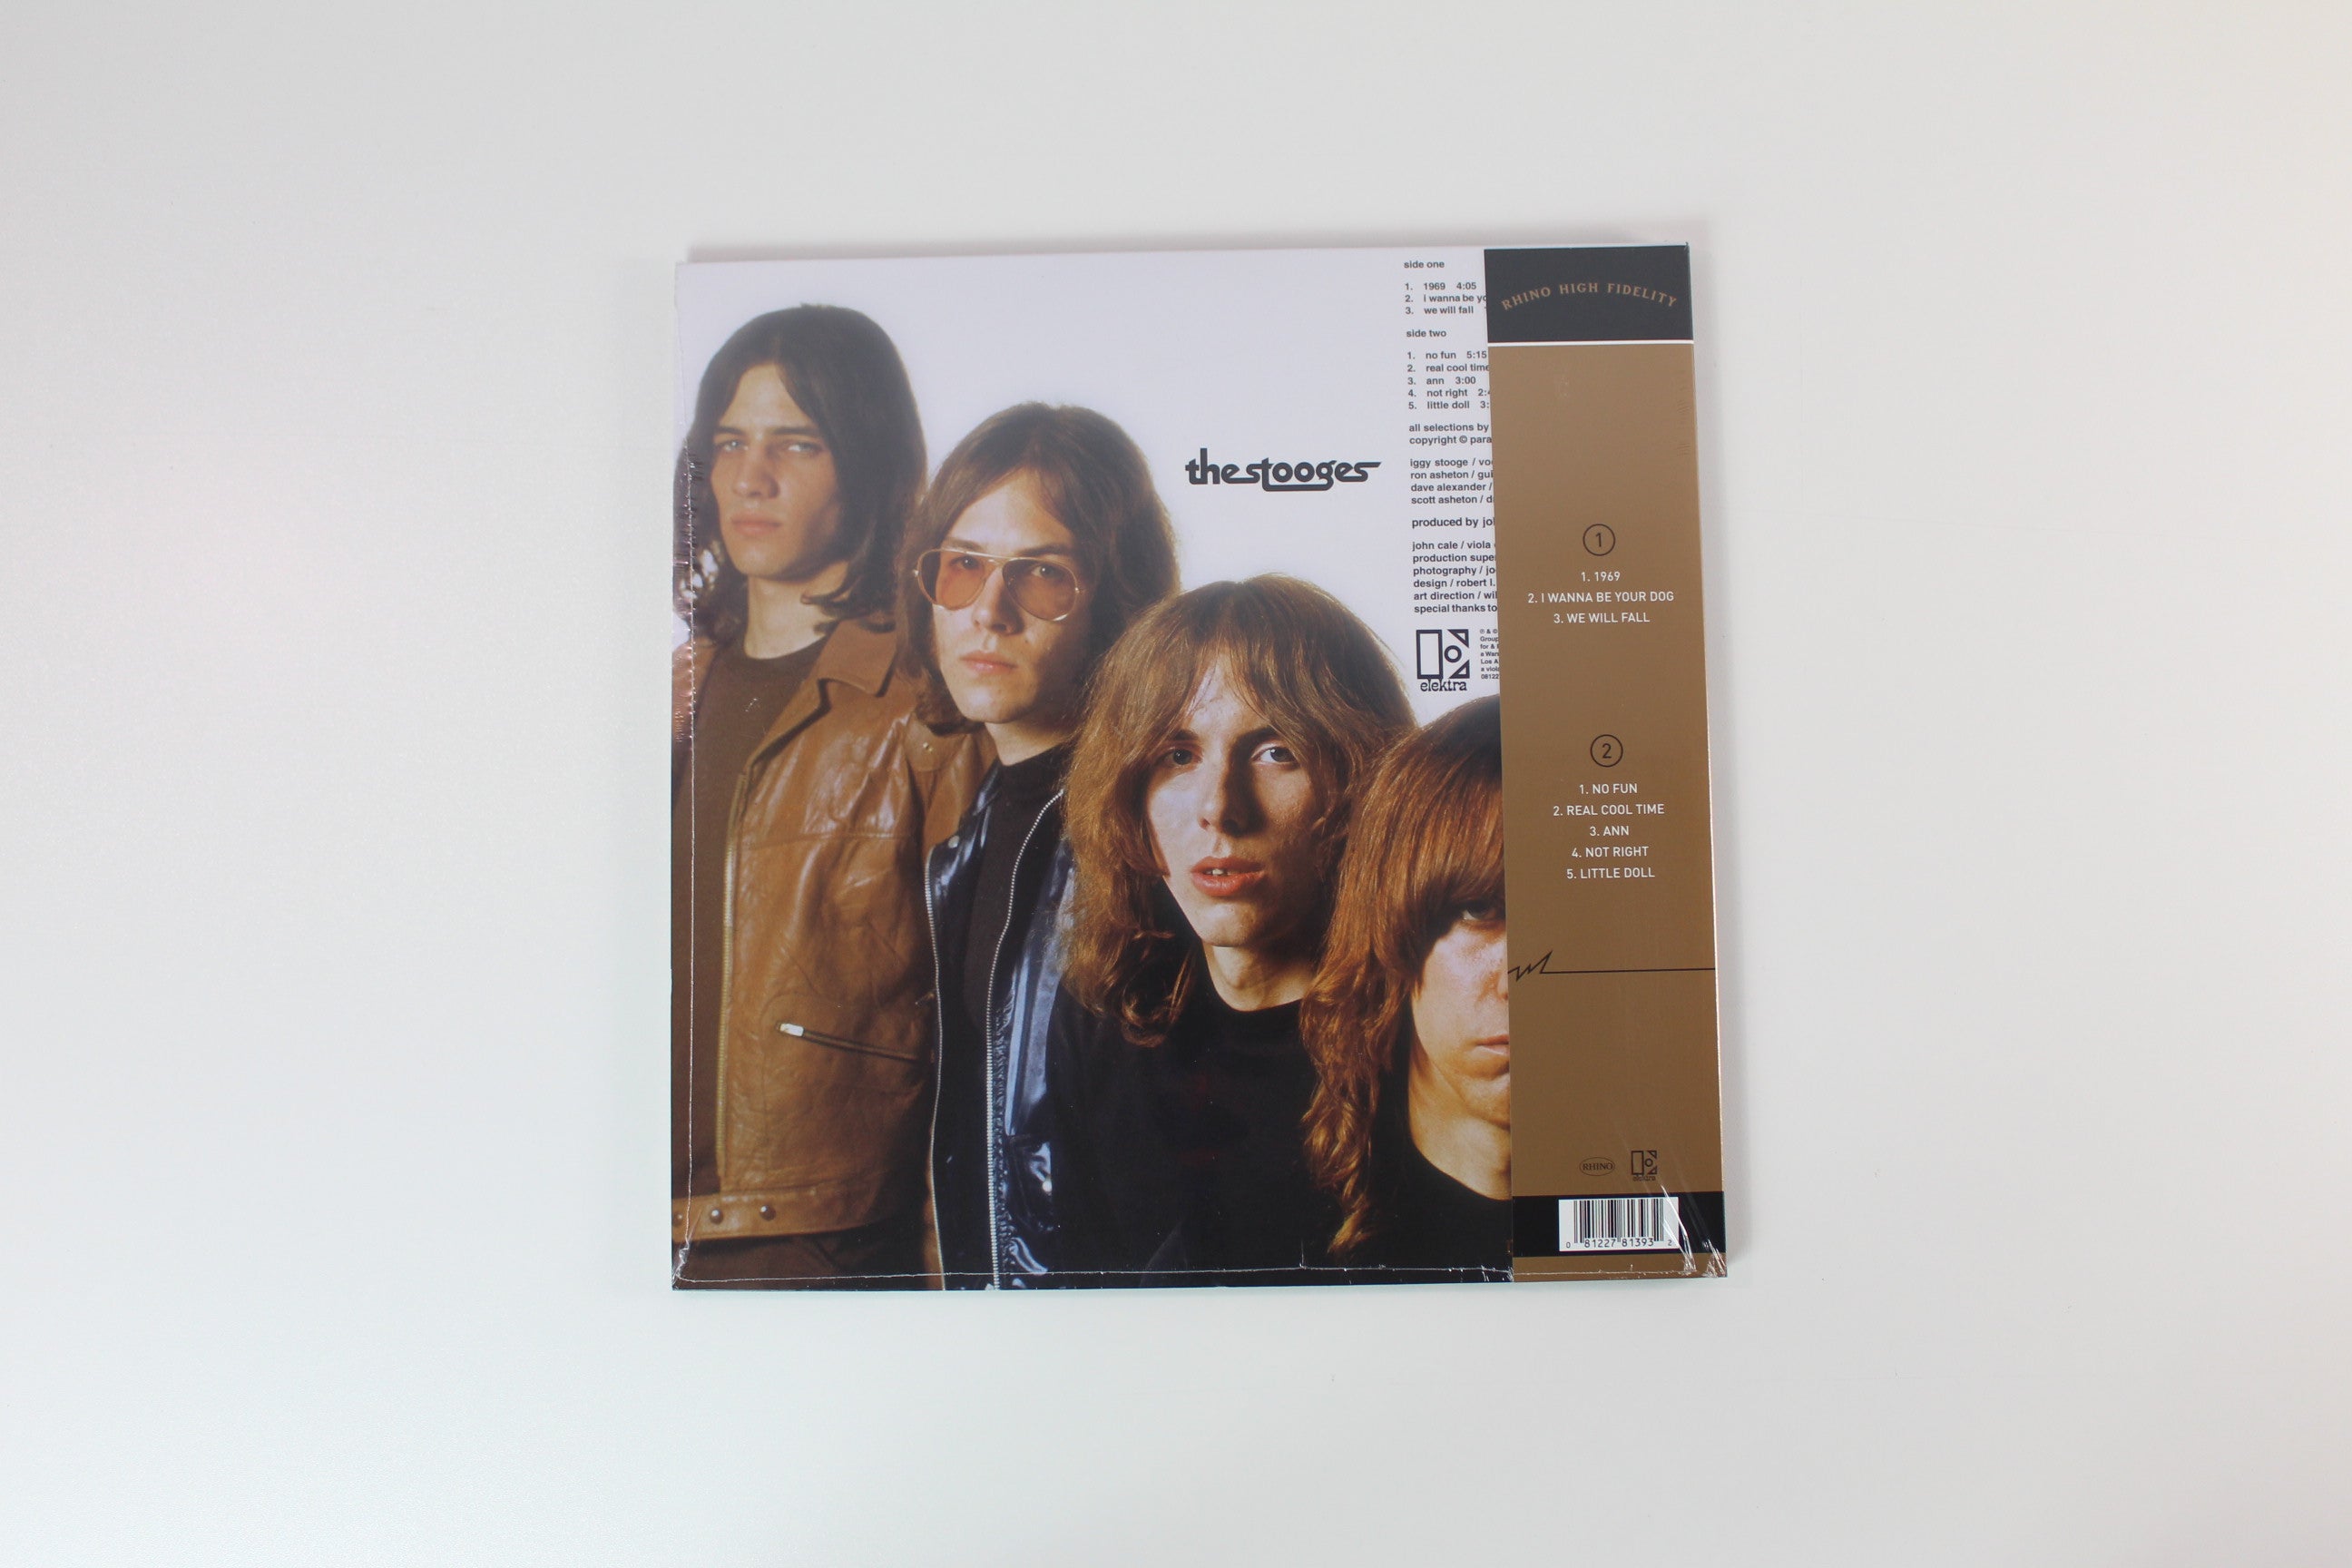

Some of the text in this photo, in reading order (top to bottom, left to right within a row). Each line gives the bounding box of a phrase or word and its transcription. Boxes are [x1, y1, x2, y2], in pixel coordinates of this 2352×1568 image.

[1404, 260, 1424, 269] side
[1501, 282, 1677, 310] RHINO HIGH FIDELITY
[1406, 329, 1426, 338] side
[1441, 351, 1456, 359] fun
[1426, 364, 1444, 372] real
[1446, 388, 1468, 398] right
[1426, 401, 1449, 409] little
[1424, 423, 1474, 431] selections
[1477, 423, 1489, 433] by
[1409, 436, 1456, 446] copyright
[1410, 459, 1431, 468] iggy
[1435, 458, 1468, 468] stooge
[1429, 471, 1469, 479] asheton
[1411, 484, 1434, 492] dave
[1436, 483, 1486, 491] alexander
[1411, 496, 1436, 505] scott
[1438, 495, 1477, 504] asheton
[1412, 517, 1462, 529] produced
[1465, 517, 1478, 528] by
[1595, 533, 1602, 547] 1
[1412, 542, 1435, 552] john
[1437, 541, 1458, 550] cale
[1466, 541, 1491, 549] viola
[1413, 554, 1467, 564] production
[1413, 566, 1476, 577] photography
[1582, 572, 1621, 582] 1. 1969
[1414, 579, 1447, 589] design
[1456, 579, 1487, 587] robert
[1414, 593, 1427, 601] art
[1430, 592, 1475, 600] direction
[1528, 593, 1537, 603] 2.
[1548, 593, 1592, 603] WANNA
[1596, 593, 1611, 602] BE
[1615, 592, 1646, 602] YOUR
[1650, 591, 1674, 602] DOG
[1414, 604, 1498, 614] special thanks to
[1553, 612, 1650, 623] 3. WE WILL FALL
[1420, 679, 1467, 691] elektra
[1602, 743, 1612, 759] 2
[1579, 783, 1638, 794] 1. NO FUN
[1553, 804, 1665, 816] 2. REAL COOL TIME
[1590, 826, 1630, 836] 3. ANN
[1572, 846, 1649, 858] 4. NOT RIGHT
[1567, 867, 1655, 878] 5. LITTLE DOLL
[1584, 1240, 1616, 1248] 81227
[1622, 1238, 1653, 1247] 81393
